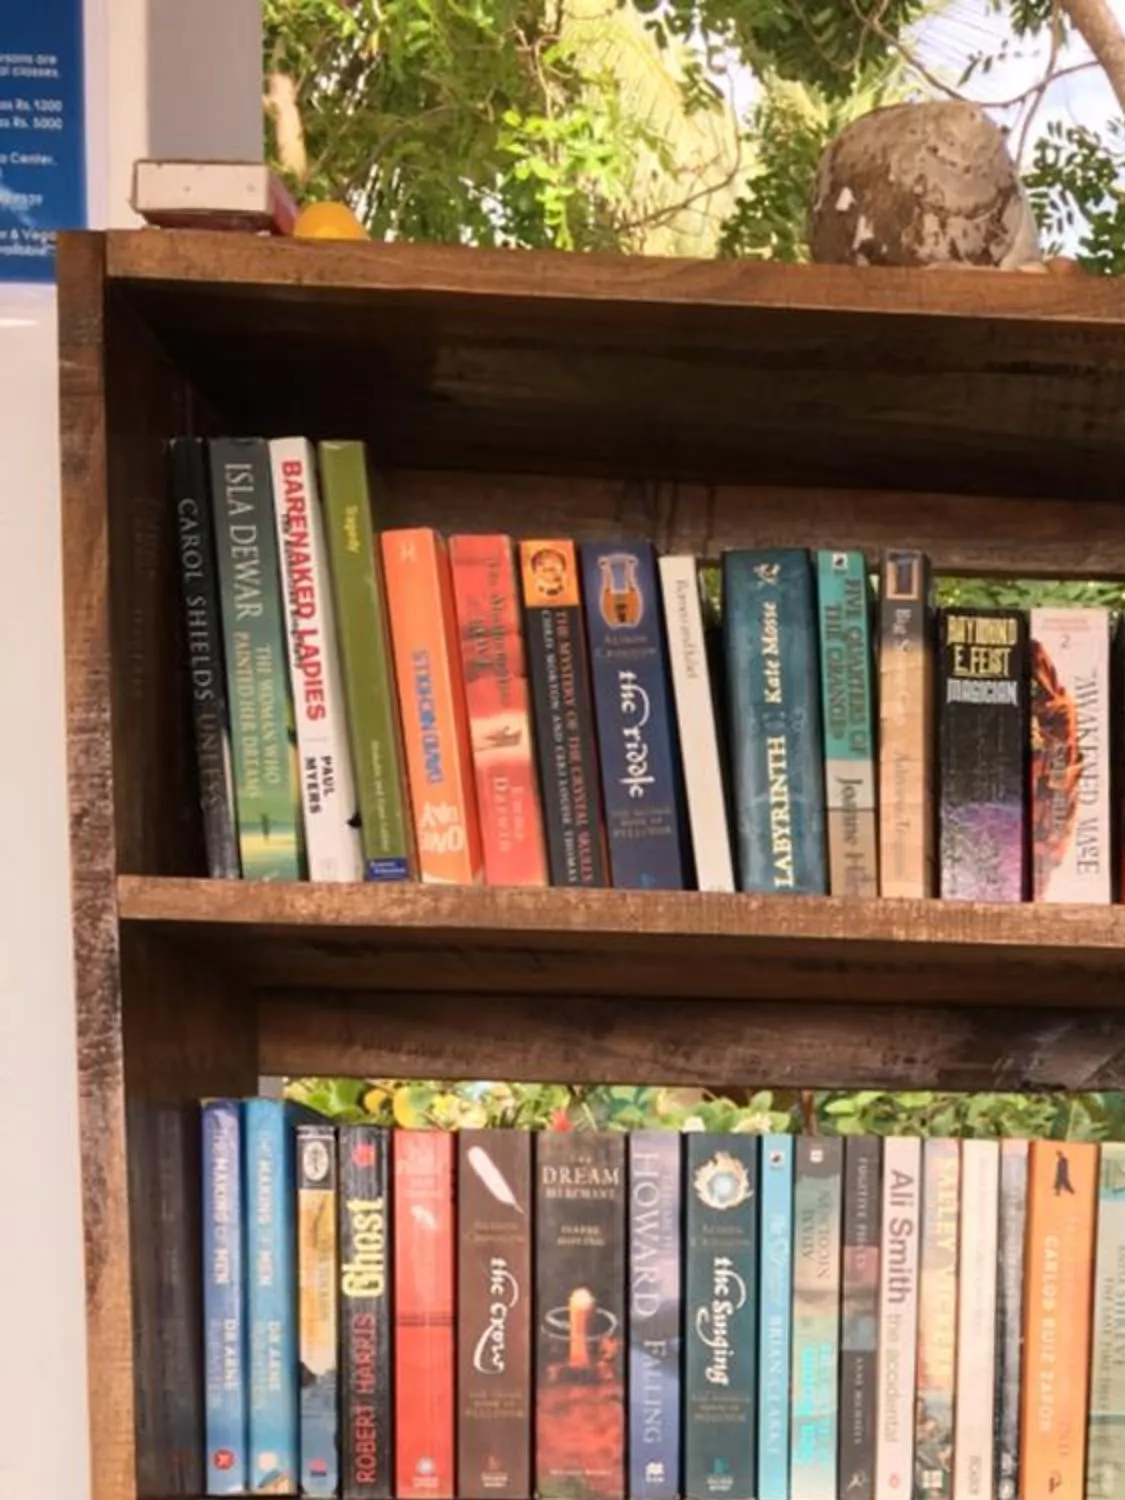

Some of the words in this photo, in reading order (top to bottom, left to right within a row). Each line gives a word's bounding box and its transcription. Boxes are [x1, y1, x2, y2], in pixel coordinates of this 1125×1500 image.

[225, 463, 255, 515] ISLA
[178, 499, 201, 581] CAROL
[230, 525, 263, 621] DEWAR
[283, 460, 314, 619] BARENAKED
[184, 597, 213, 700] SHIELDS
[761, 602, 780, 654] Mosse
[970, 647, 1011, 677] FEIST
[297, 629, 326, 720] LADIES
[763, 659, 782, 703] Kate
[306, 757, 321, 814] MYERS
[321, 756, 335, 796] PAUL
[766, 736, 793, 888] LABYRINTH
[542, 1166, 620, 1185] DREAM
[891, 1170, 913, 1207] Ali
[341, 1197, 385, 1298] Ghost
[632, 1151, 659, 1317] HOWARD
[887, 1217, 913, 1303] Smith
[352, 1313, 377, 1394] HARRIS
[888, 1314, 904, 1342] the
[642, 1339, 667, 1442] FALLING
[885, 1348, 902, 1442] accidental
[355, 1404, 377, 1483] ROBERT
